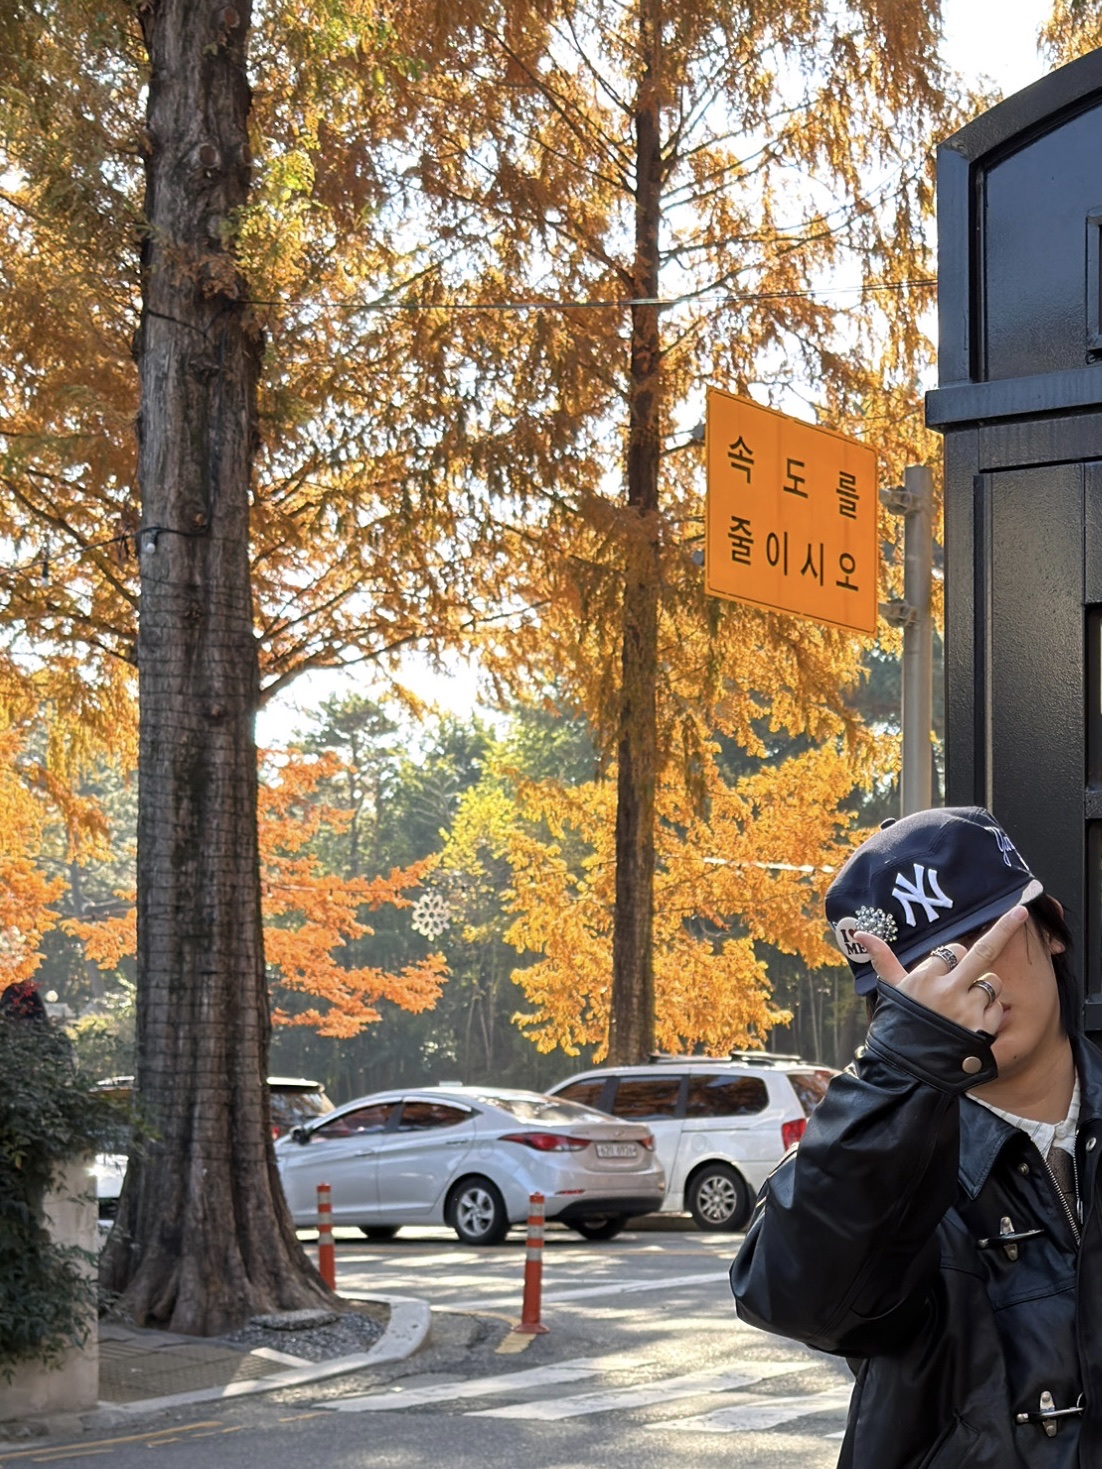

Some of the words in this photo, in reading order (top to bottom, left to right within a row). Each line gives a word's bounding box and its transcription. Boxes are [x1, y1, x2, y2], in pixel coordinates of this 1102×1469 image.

[727, 515, 860, 592] 줄이시오
[891, 863, 954, 928] NY
[840, 928, 849, 943] I
